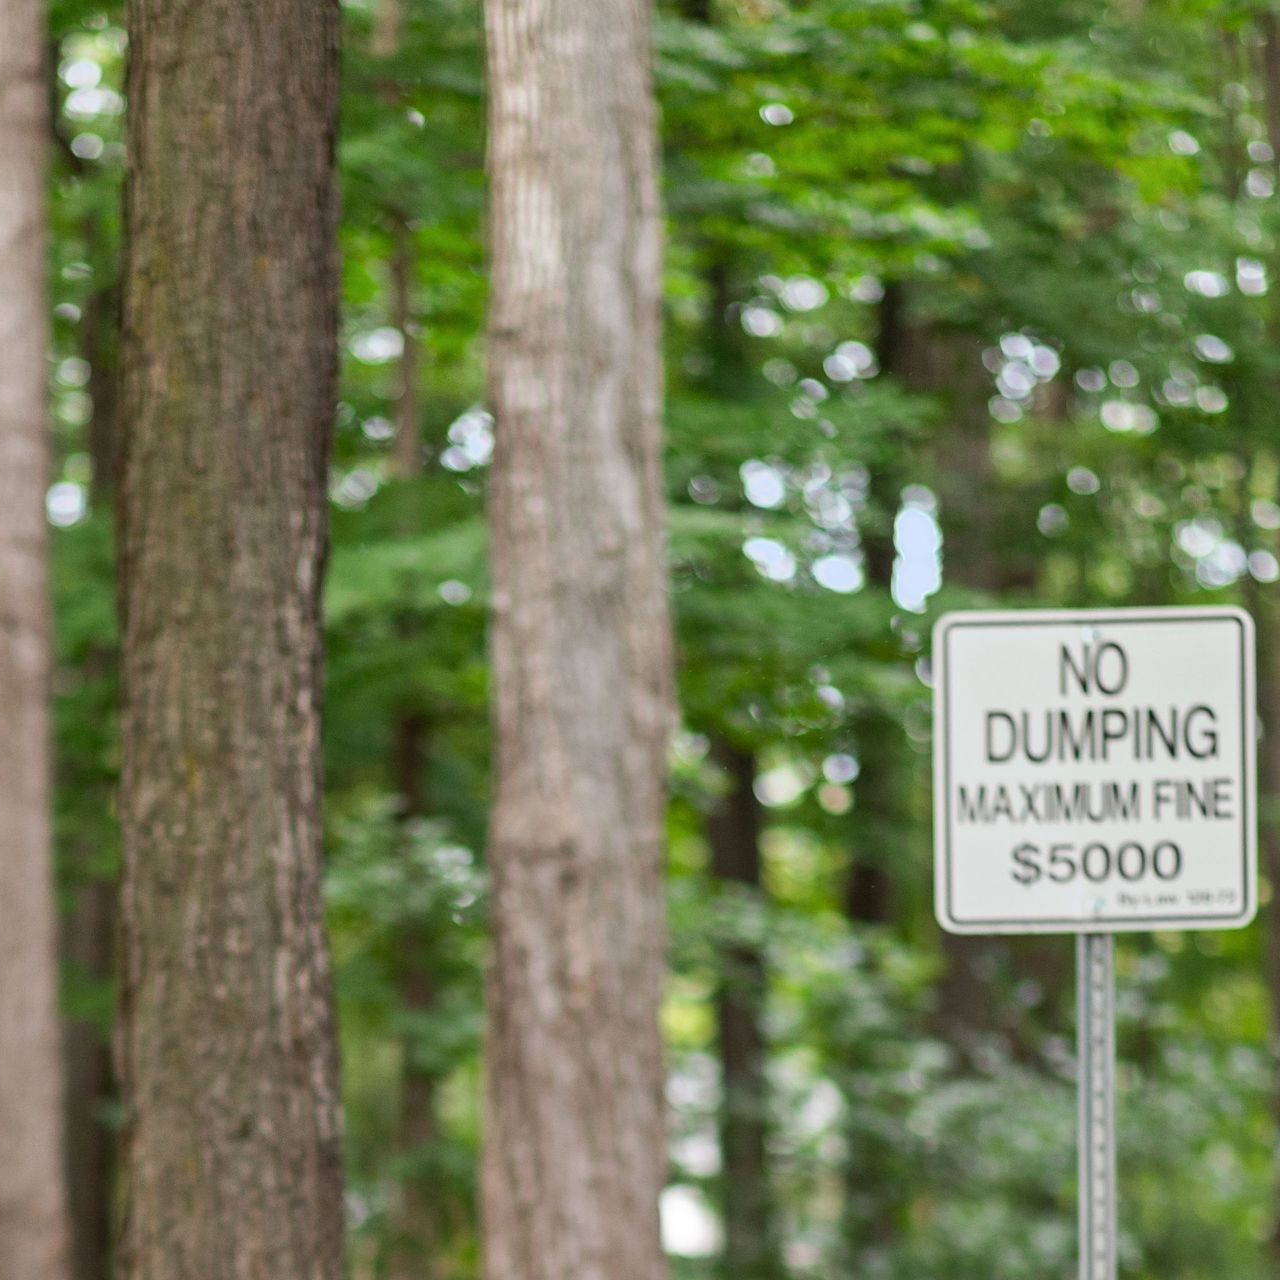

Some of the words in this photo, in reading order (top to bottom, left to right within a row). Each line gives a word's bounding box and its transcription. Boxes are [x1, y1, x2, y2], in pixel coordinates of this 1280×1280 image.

[1060, 642, 1128, 696] NO
[986, 705, 1218, 763] DUMPING
[957, 781, 1141, 824] MAXIMUM
[1153, 779, 1234, 820] FINE
[1011, 841, 1183, 887] $5000
